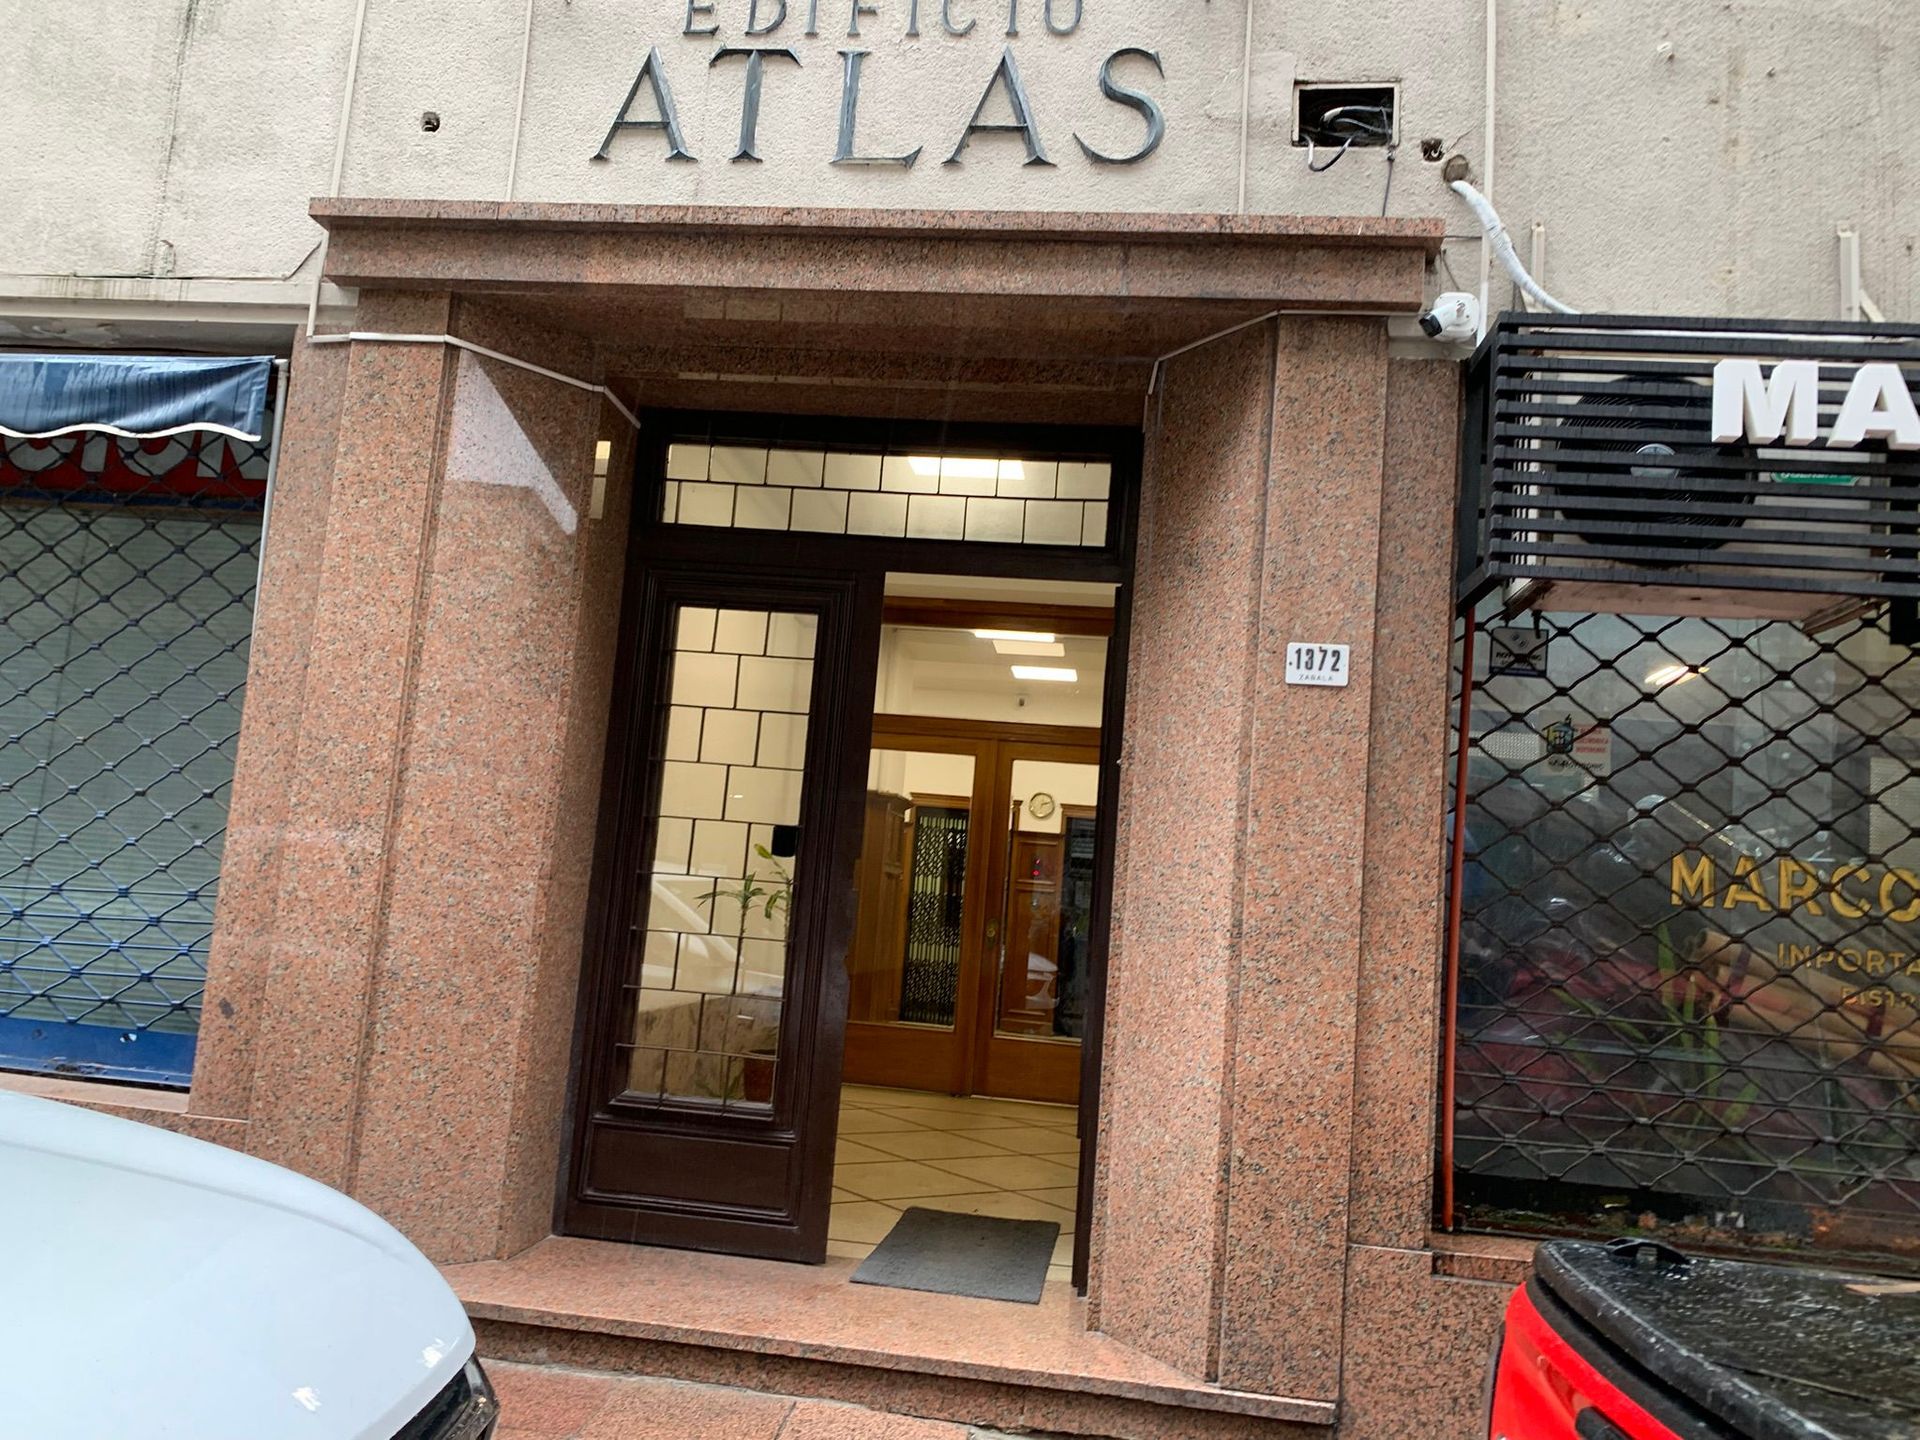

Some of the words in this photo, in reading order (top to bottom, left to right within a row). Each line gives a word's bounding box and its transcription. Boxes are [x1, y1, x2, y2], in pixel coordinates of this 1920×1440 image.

[590, 45, 1165, 167] ATLAS
[1712, 358, 1920, 450] MA
[1295, 646, 1341, 672] 1372
[1671, 852, 1920, 922] MARCO
